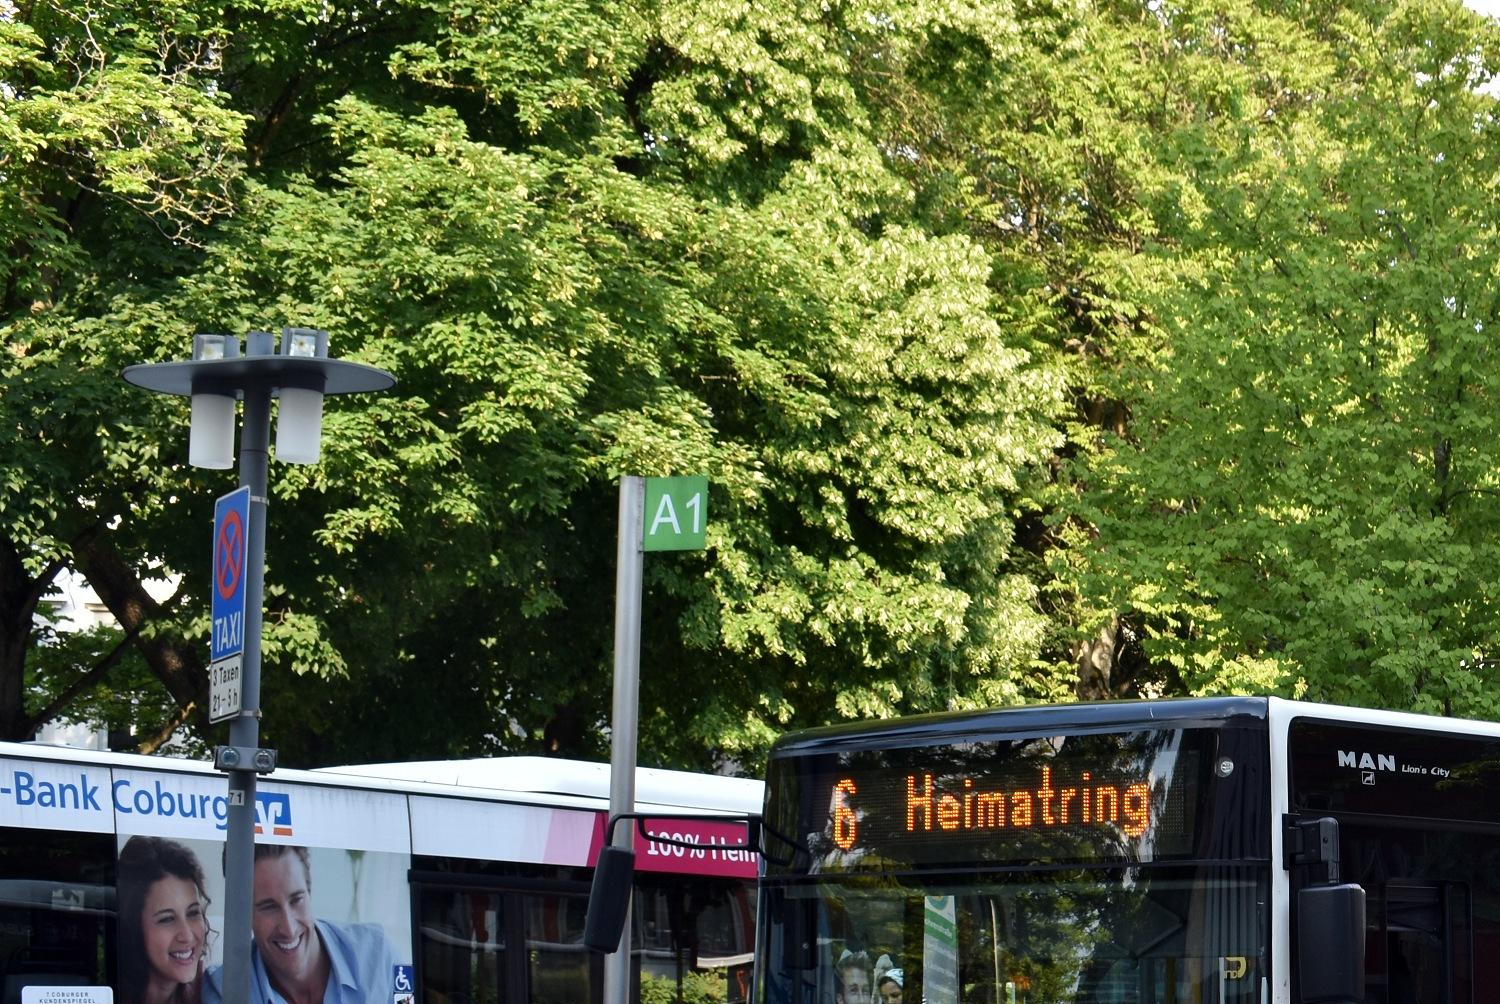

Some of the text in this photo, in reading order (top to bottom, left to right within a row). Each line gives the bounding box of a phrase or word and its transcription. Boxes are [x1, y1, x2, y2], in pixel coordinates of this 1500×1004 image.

[649, 492, 701, 536] A1
[215, 611, 241, 653] TAXI
[213, 667, 239, 687] 3 Taxen
[1337, 750, 1450, 778] MAN Lion's City
[113, 780, 229, 830] Coburg
[834, 766, 1150, 850] 6 Heimatring
[648, 831, 704, 859] 100%
